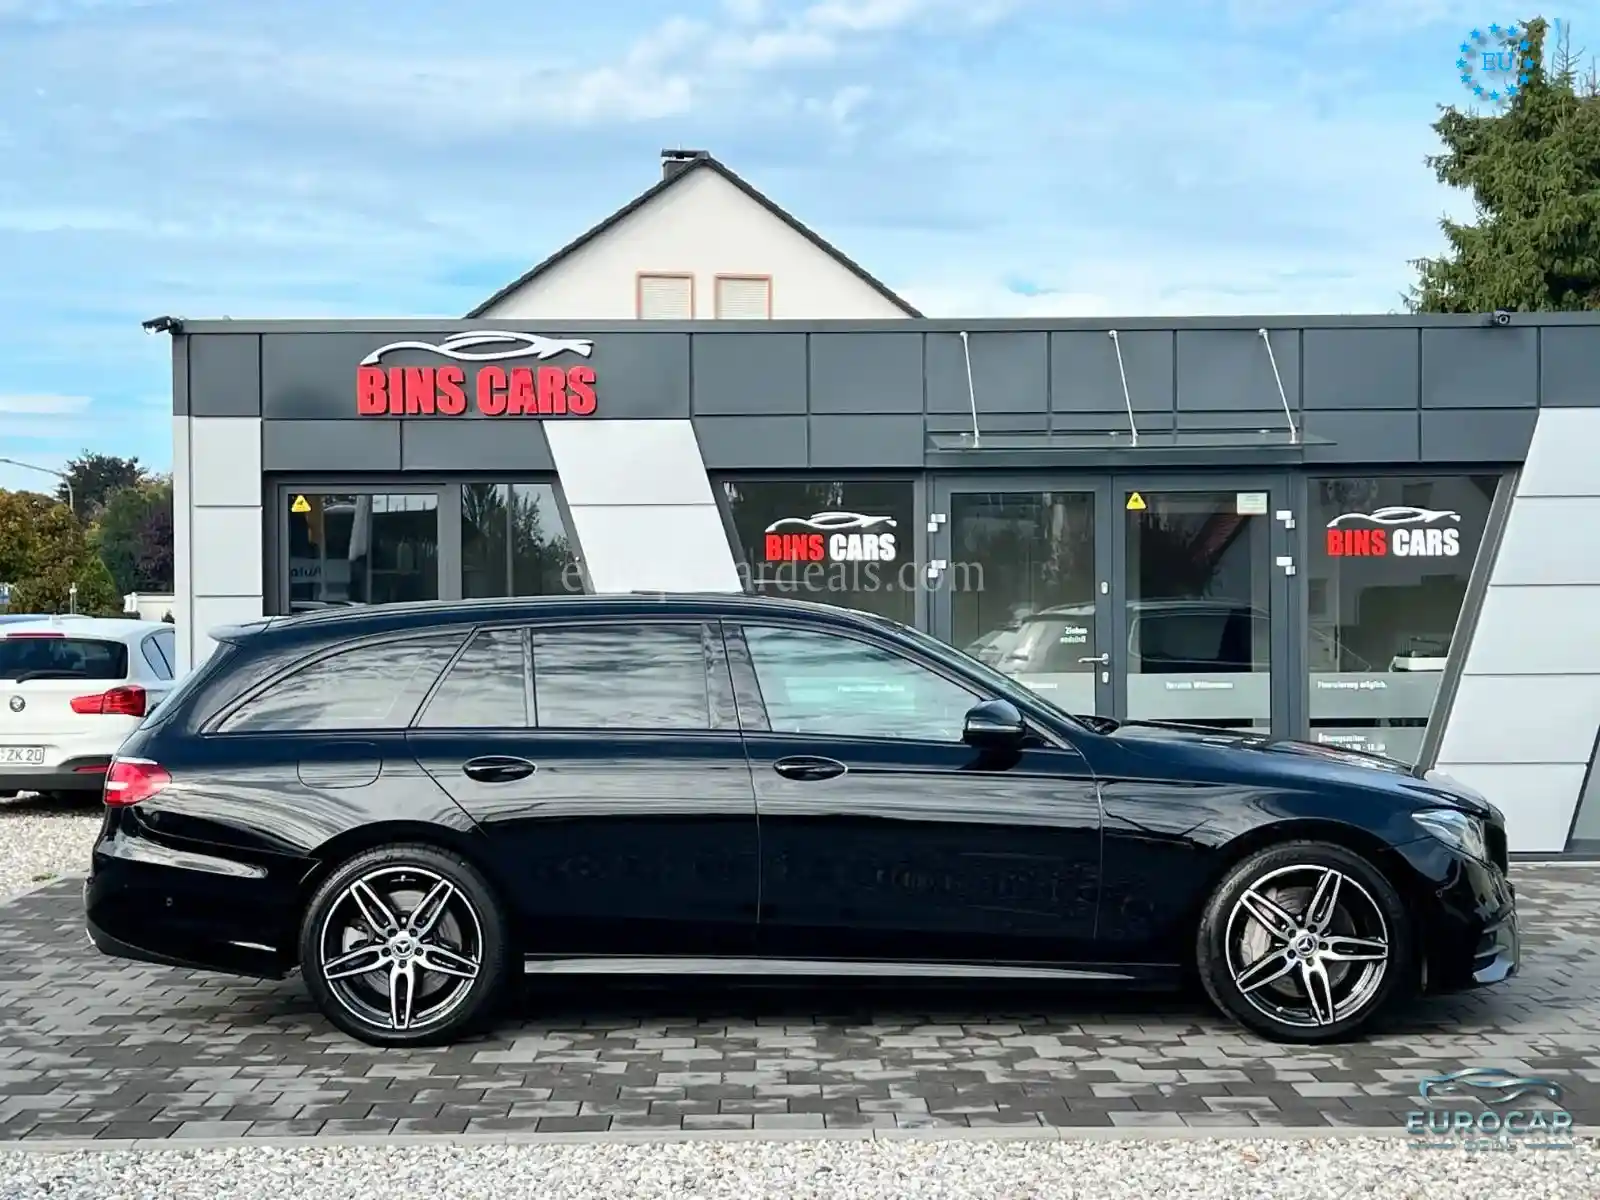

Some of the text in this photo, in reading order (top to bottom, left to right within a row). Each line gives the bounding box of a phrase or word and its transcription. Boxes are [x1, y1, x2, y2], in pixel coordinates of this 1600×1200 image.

[357, 366, 597, 416] BINS CARS
[765, 533, 897, 561] BINS CARS
[1327, 528, 1460, 556] BINS CARS
